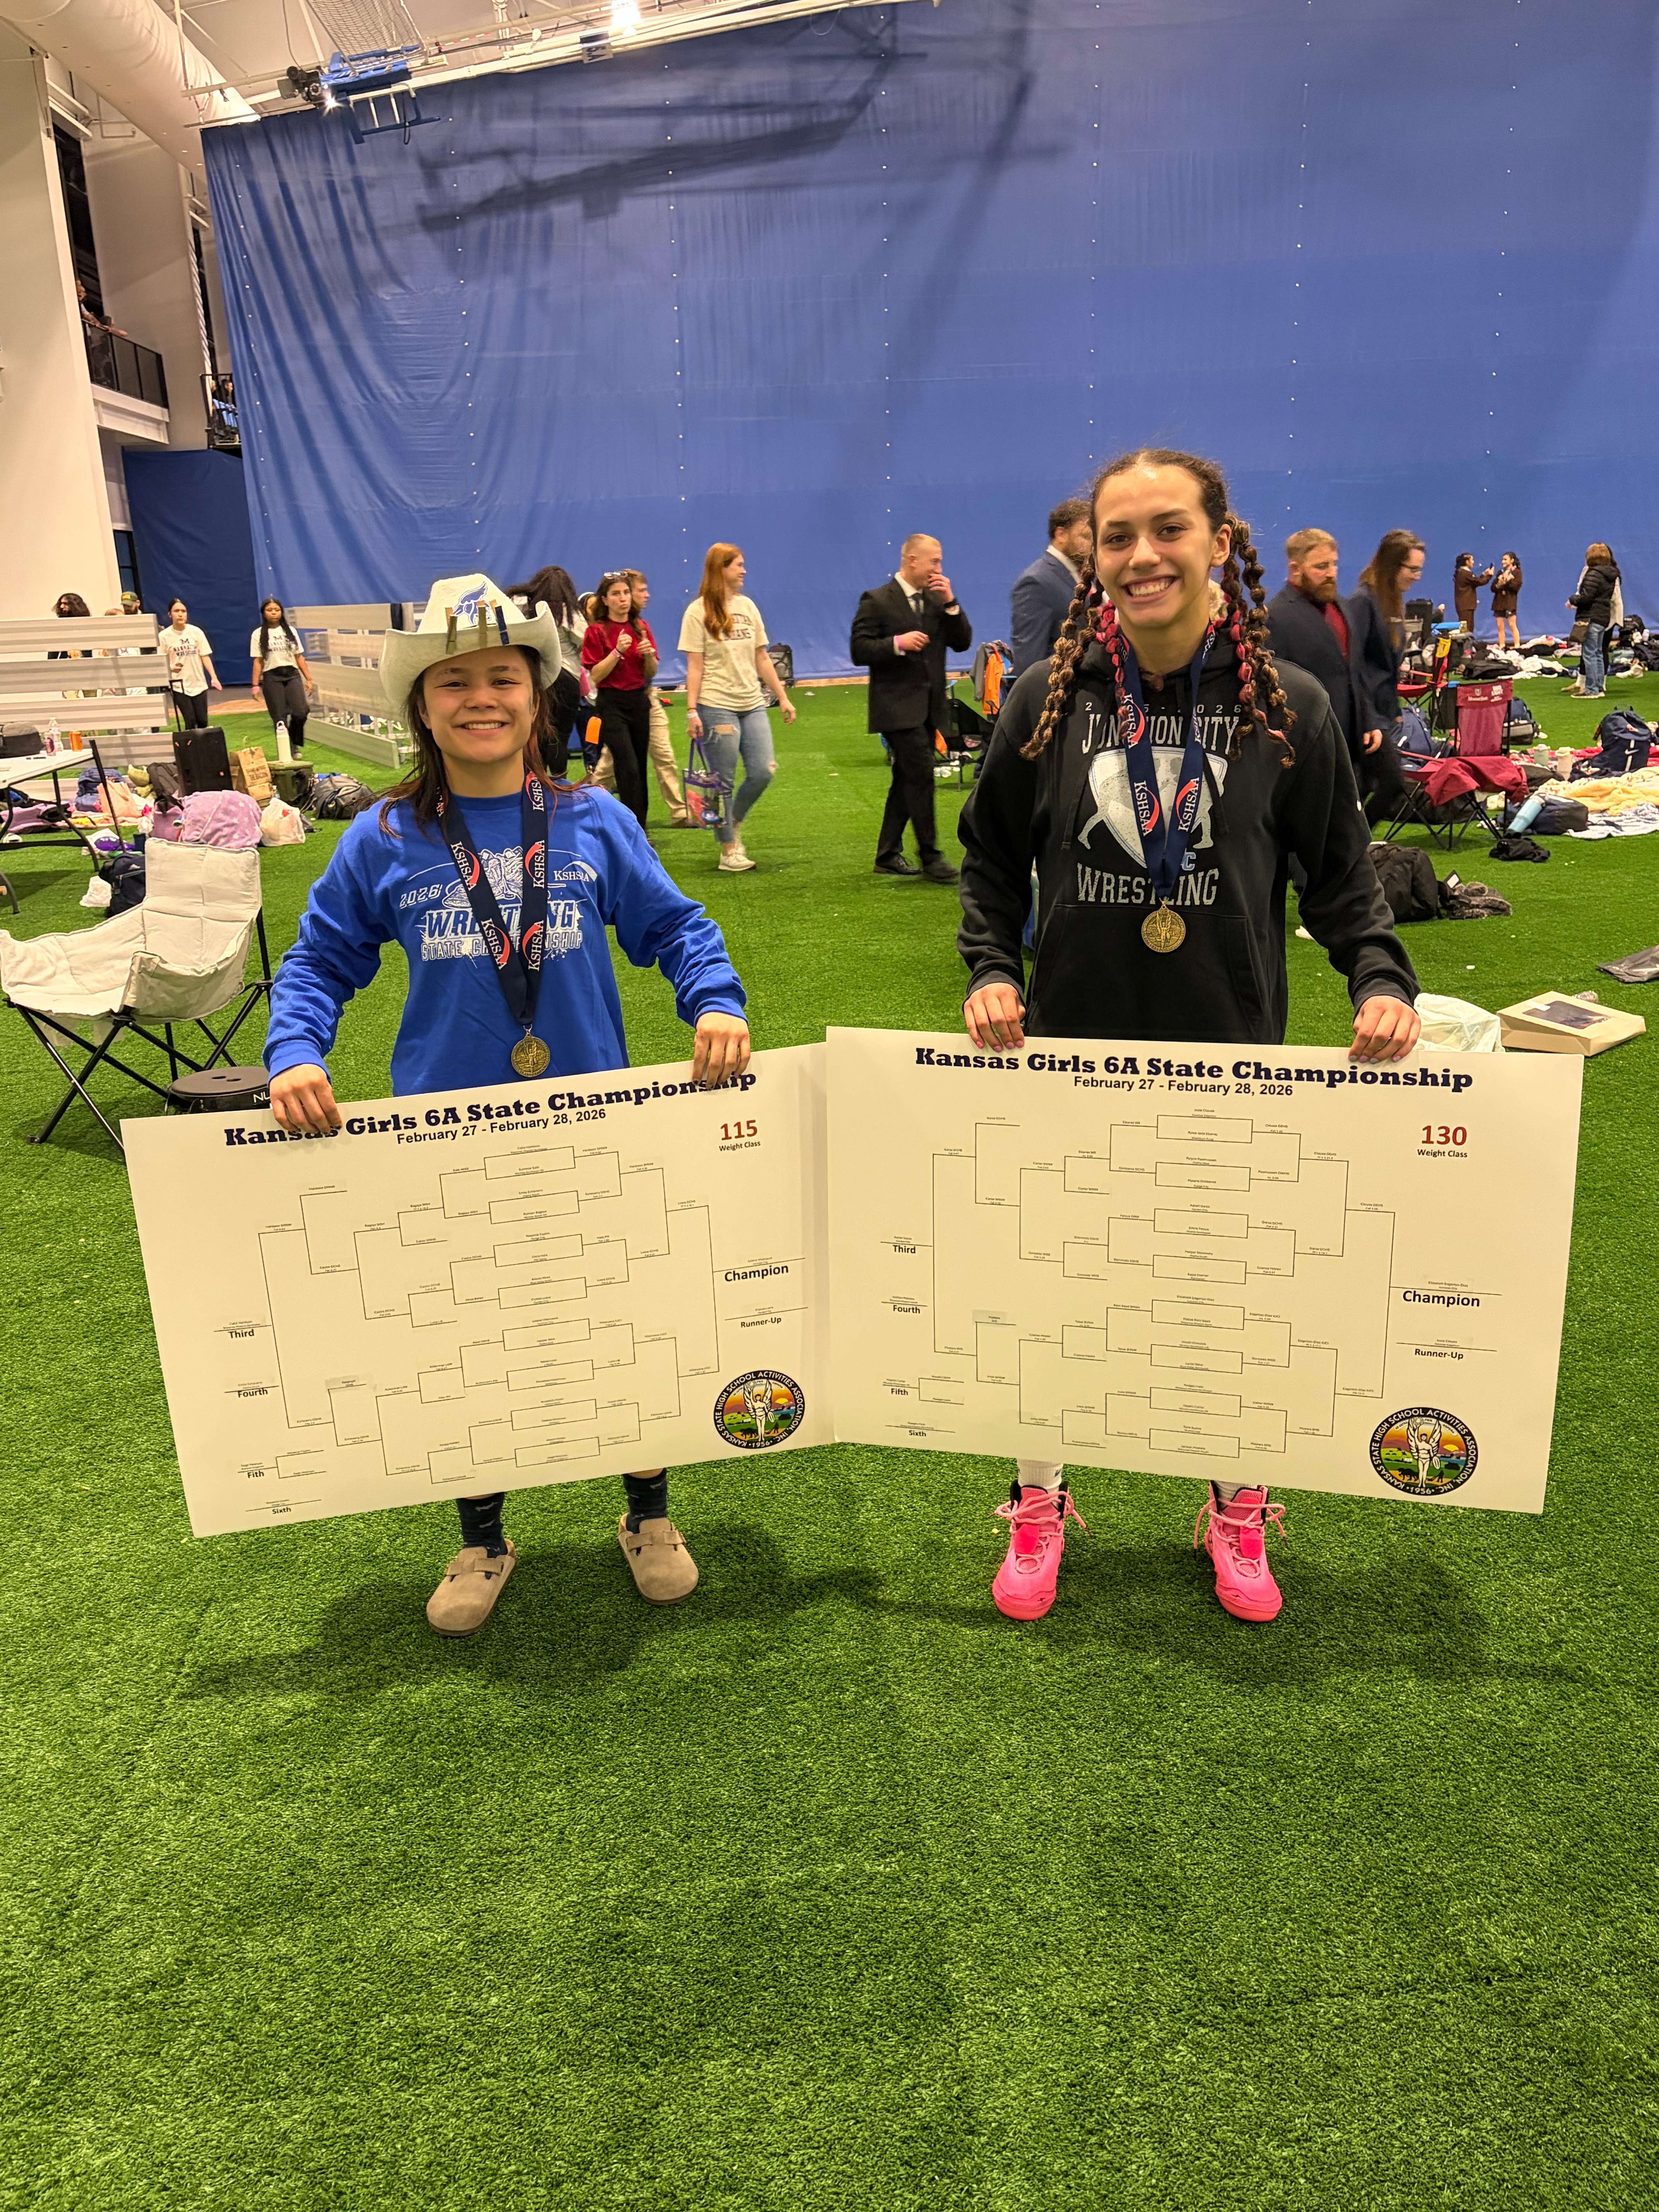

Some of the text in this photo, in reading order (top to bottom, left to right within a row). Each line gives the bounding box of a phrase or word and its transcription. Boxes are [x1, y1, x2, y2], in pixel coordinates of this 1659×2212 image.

[1082, 714, 1183, 754] JNION
[1197, 716, 1239, 755] ITY
[531, 777, 544, 812] KSHS
[1178, 777, 1200, 832] KSHSAA
[1134, 780, 1153, 836] KSHSAA
[450, 841, 477, 891] KSHSAA
[533, 840, 545, 889] KSHSAA
[1180, 851, 1196, 871] C
[1077, 862, 1219, 906] WRESING
[400, 884, 443, 909] 2026
[426, 900, 577, 941] WRTNG
[421, 931, 582, 962] STATE CHNSHIP
[481, 918, 507, 970] KSHSAA
[528, 920, 544, 972] KSHSAA
[916, 1048, 1473, 1093] Kansas Girls 6A State Championship
[1075, 1077, 1134, 1091] February
[1139, 1079, 1154, 1090] 27
[1169, 1080, 1230, 1096] February
[1235, 1083, 1255, 1096] 28,
[1260, 1084, 1293, 1096] 2026
[346, 1114, 417, 1135] Girls
[425, 1107, 461, 1126] 6A
[467, 1100, 540, 1122] State
[397, 1130, 458, 1144] February
[462, 1125, 477, 1137] 27
[491, 1118, 549, 1133] February
[553, 1114, 572, 1125] 28,
[576, 1109, 606, 1122] 2026
[721, 1120, 758, 1140] 115
[1422, 1125, 1467, 1146] 130
[719, 1139, 760, 1152] Weight Class
[1417, 1149, 1445, 1159] Weight
[893, 1245, 916, 1254] Third
[725, 1264, 789, 1282] Champion
[1403, 1290, 1480, 1307] Champion
[893, 1305, 921, 1314] Fourth
[740, 1317, 782, 1328] Runner-Up
[228, 1329, 254, 1339] Third
[1415, 1348, 1463, 1360] Runner-Up
[726, 1373, 756, 1392] SCHOOL
[758, 1371, 794, 1388] ACTIVITIES
[237, 1388, 268, 1398] Fourth
[716, 1394, 728, 1410] HIGH
[787, 1388, 804, 1431] ASSOCIATION,
[715, 1412, 725, 1431] STATE
[722, 1431, 747, 1447] KANSAS
[773, 1432, 789, 1442] INC.
[1371, 1408, 1476, 1493] KANSAS STATE HIGH SCHOOL ACTIVITIES ASSOCIATION, INC.
[247, 1470, 264, 1479] Fith
[1410, 1486, 1432, 1494] 1956
